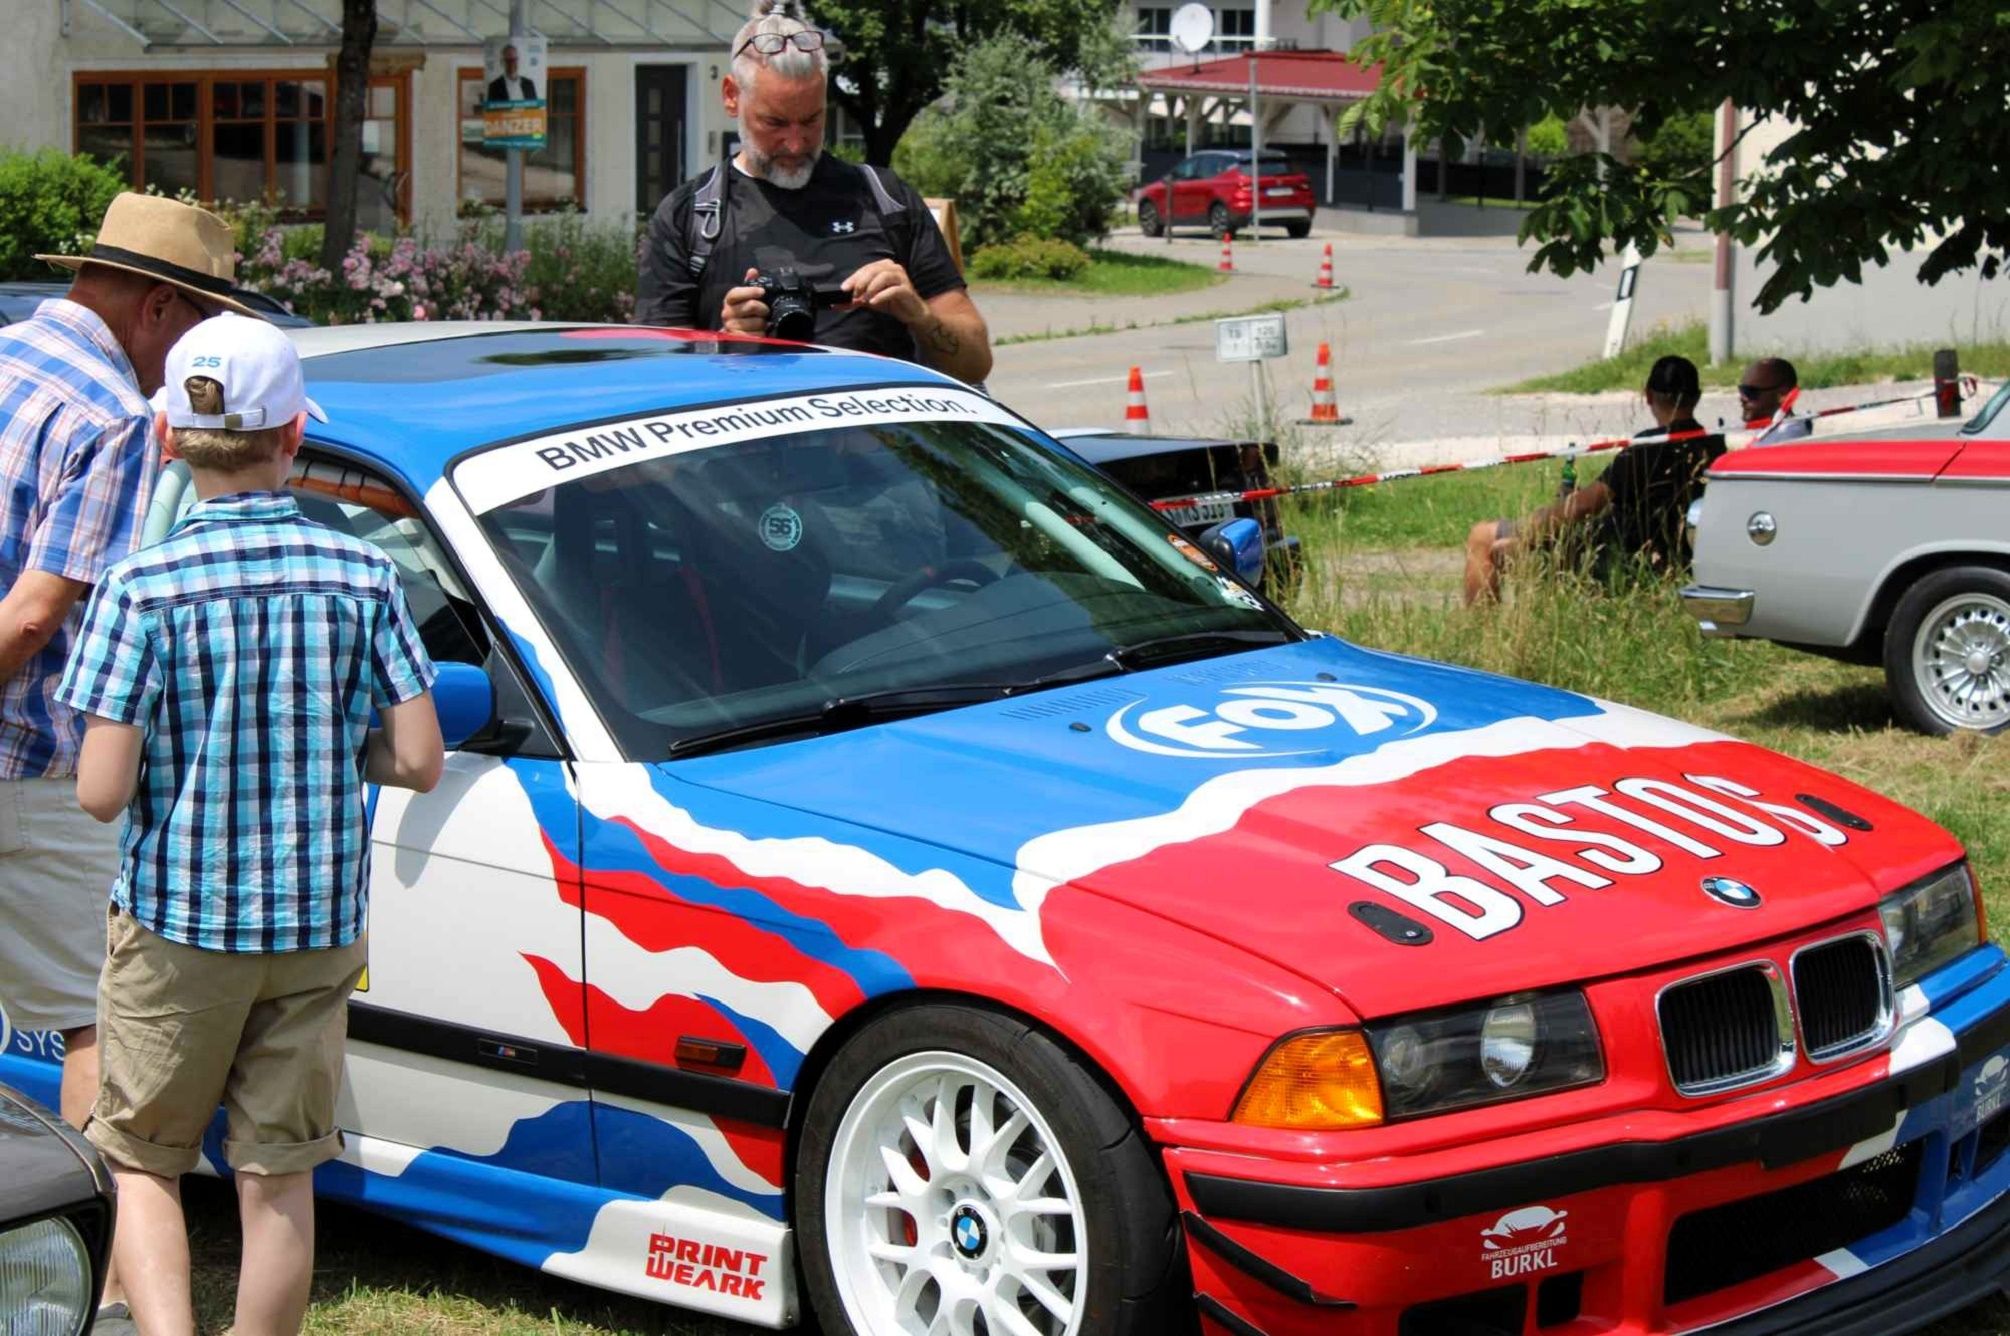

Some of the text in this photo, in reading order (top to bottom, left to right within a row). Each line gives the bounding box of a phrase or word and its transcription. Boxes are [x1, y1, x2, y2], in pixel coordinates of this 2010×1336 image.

[192, 356, 221, 368] 25
[536, 394, 977, 471] BMW Premium Selection.
[1138, 687, 1408, 749] FOX
[1327, 772, 1849, 941] BASTOS
[645, 1252, 766, 1301] WEARK
[649, 1233, 768, 1276] PRINT
[1491, 1248, 1558, 1279] BURKL
